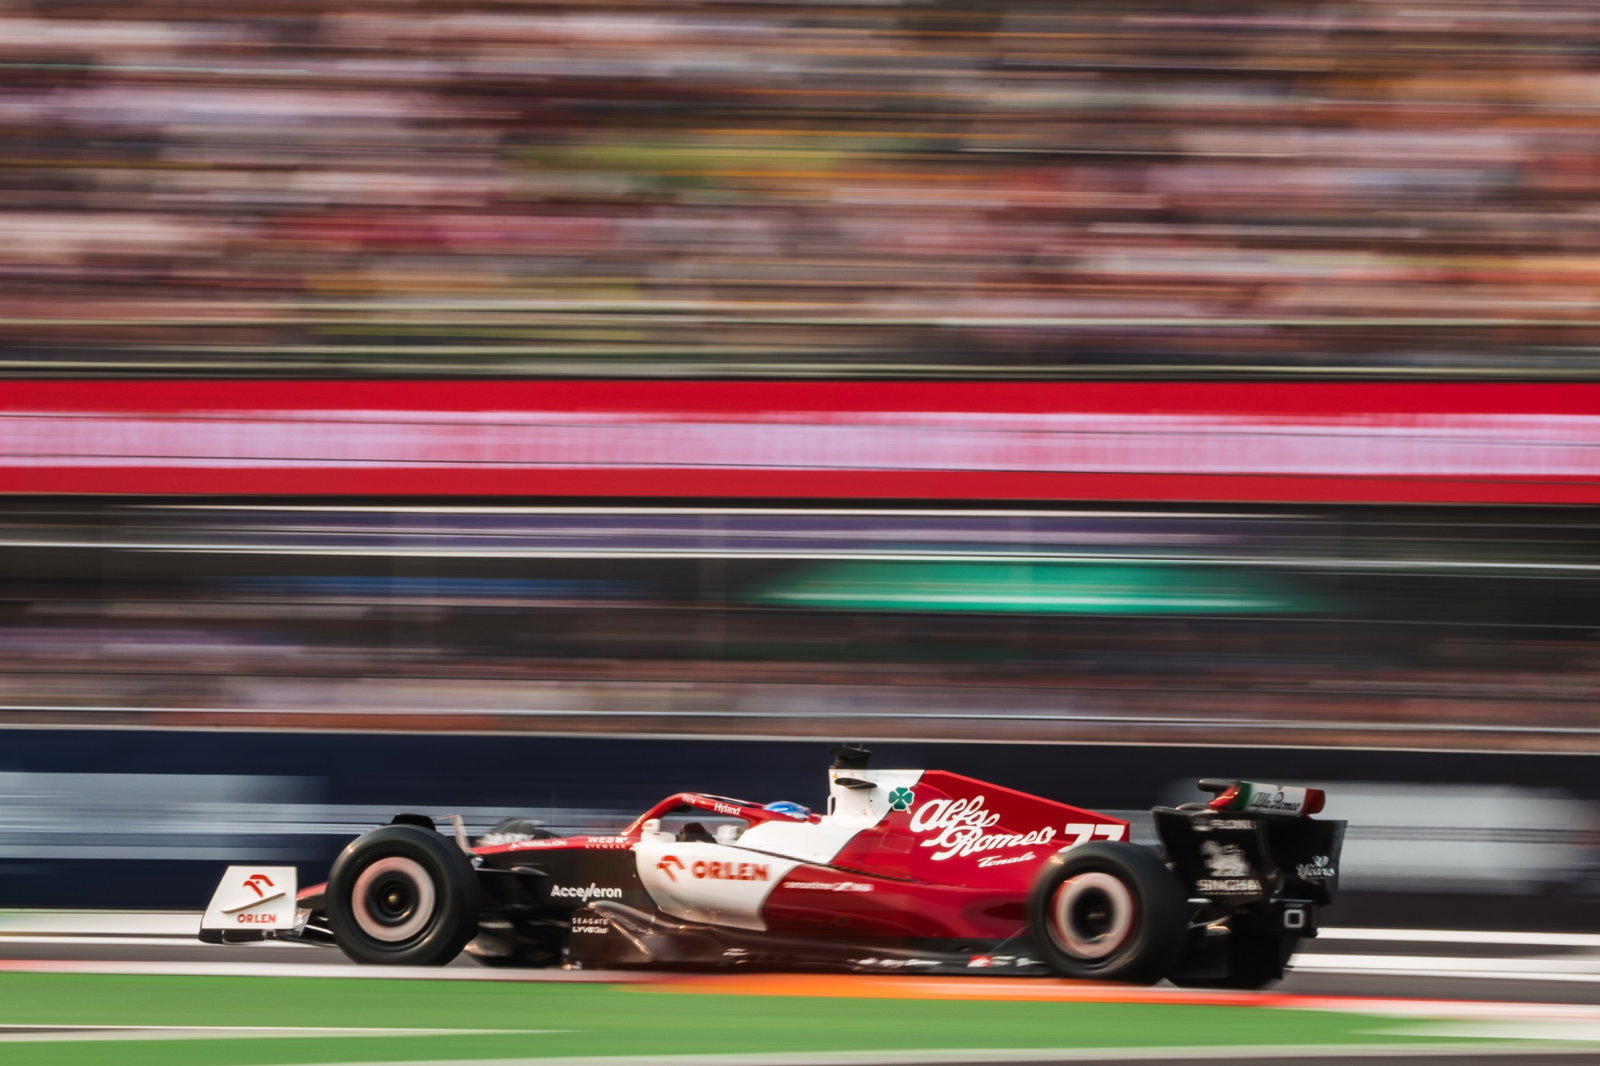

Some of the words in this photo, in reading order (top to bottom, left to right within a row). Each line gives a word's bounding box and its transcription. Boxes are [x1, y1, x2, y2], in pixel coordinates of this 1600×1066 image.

[714, 802, 742, 816] Hyland
[909, 795, 1001, 833] Alfa
[920, 825, 1057, 861] Romeo
[1057, 823, 1126, 853] 77
[977, 851, 1037, 868] Tonale
[691, 860, 769, 881] ORLEN
[237, 913, 277, 923] ORLEN
[572, 917, 609, 925] SEAGATE
